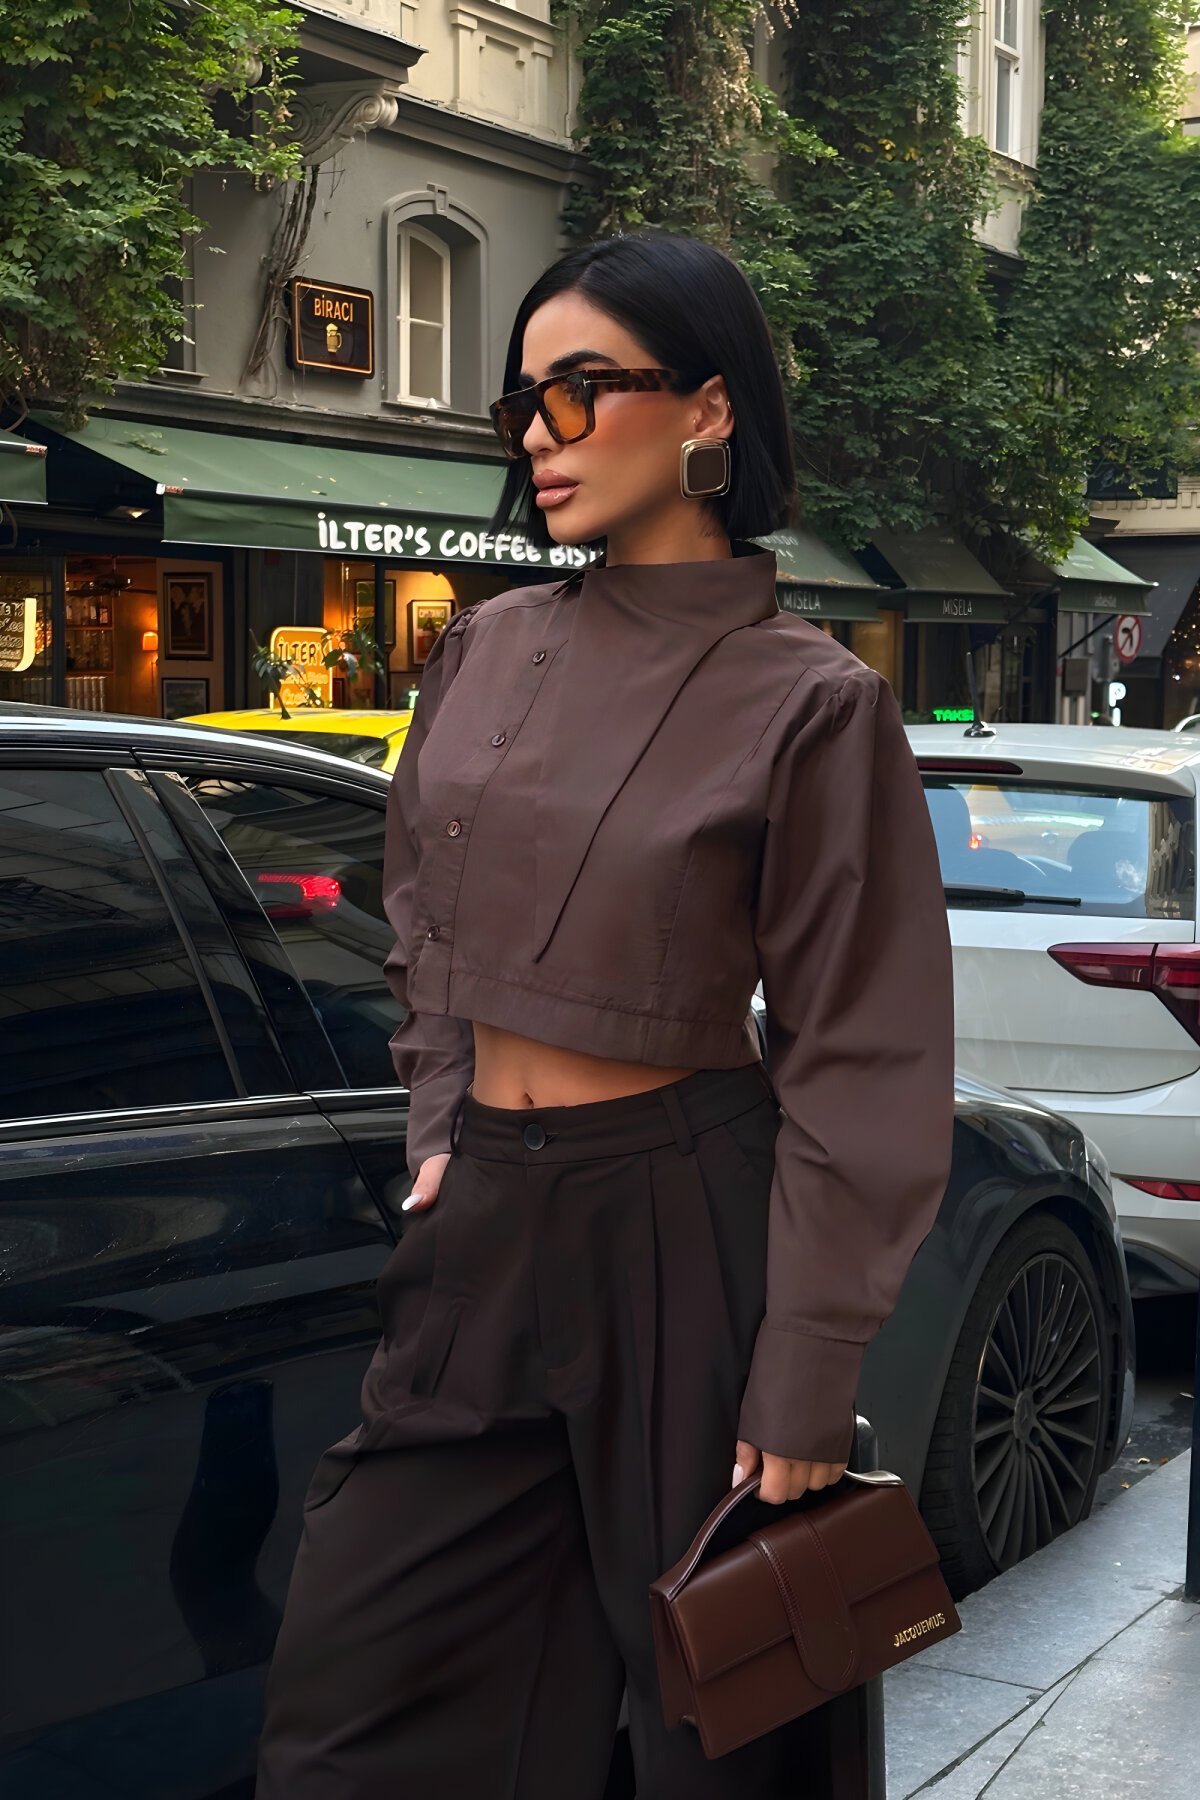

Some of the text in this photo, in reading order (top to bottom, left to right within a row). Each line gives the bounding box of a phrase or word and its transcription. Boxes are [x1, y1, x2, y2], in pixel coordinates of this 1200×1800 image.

[314, 294, 354, 323] BİRACI
[317, 511, 431, 556] İLTER'S
[439, 529, 542, 562] COFFEE
[783, 591, 821, 610] MISELA
[942, 598, 973, 616] MISELA
[893, 1612, 946, 1648] JACQUEMUS
